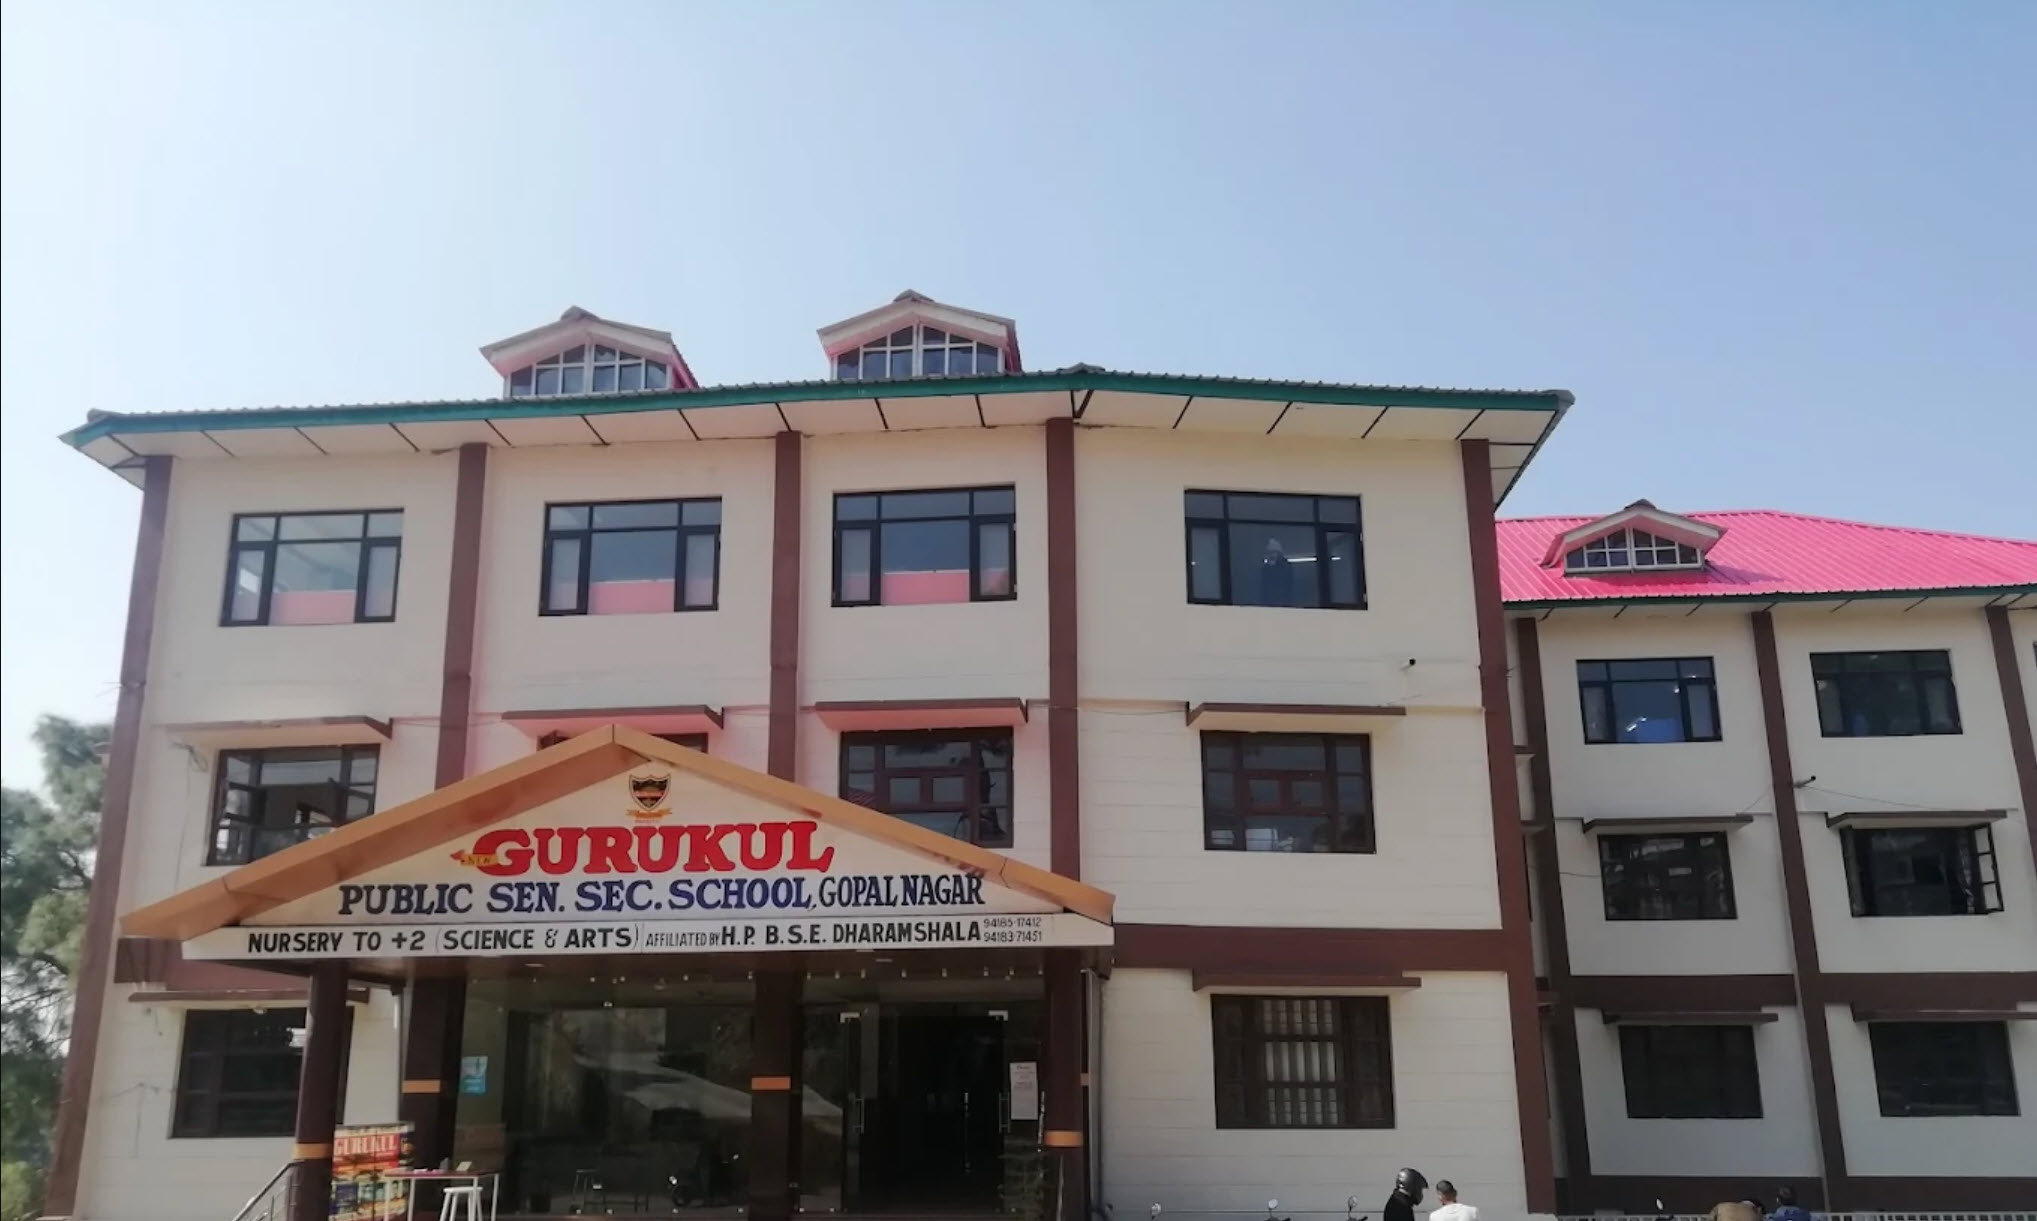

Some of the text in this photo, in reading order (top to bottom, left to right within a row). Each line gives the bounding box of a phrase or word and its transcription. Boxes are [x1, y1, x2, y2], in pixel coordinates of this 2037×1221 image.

[472, 821, 835, 876] GURUKUL
[338, 883, 473, 915] PUBLIC
[486, 881, 565, 913] SEN.
[574, 879, 663, 912] SEC.
[818, 875, 898, 908] GOPAL
[900, 873, 986, 906] NAGAR
[248, 923, 639, 953] NURSERY TO +2 (SCIENCE & ARTS)
[645, 931, 708, 947] AFFILIATED
[709, 931, 721, 945] BY
[766, 924, 827, 945] B.S.E.
[833, 921, 981, 944] DHARAMSHALA
